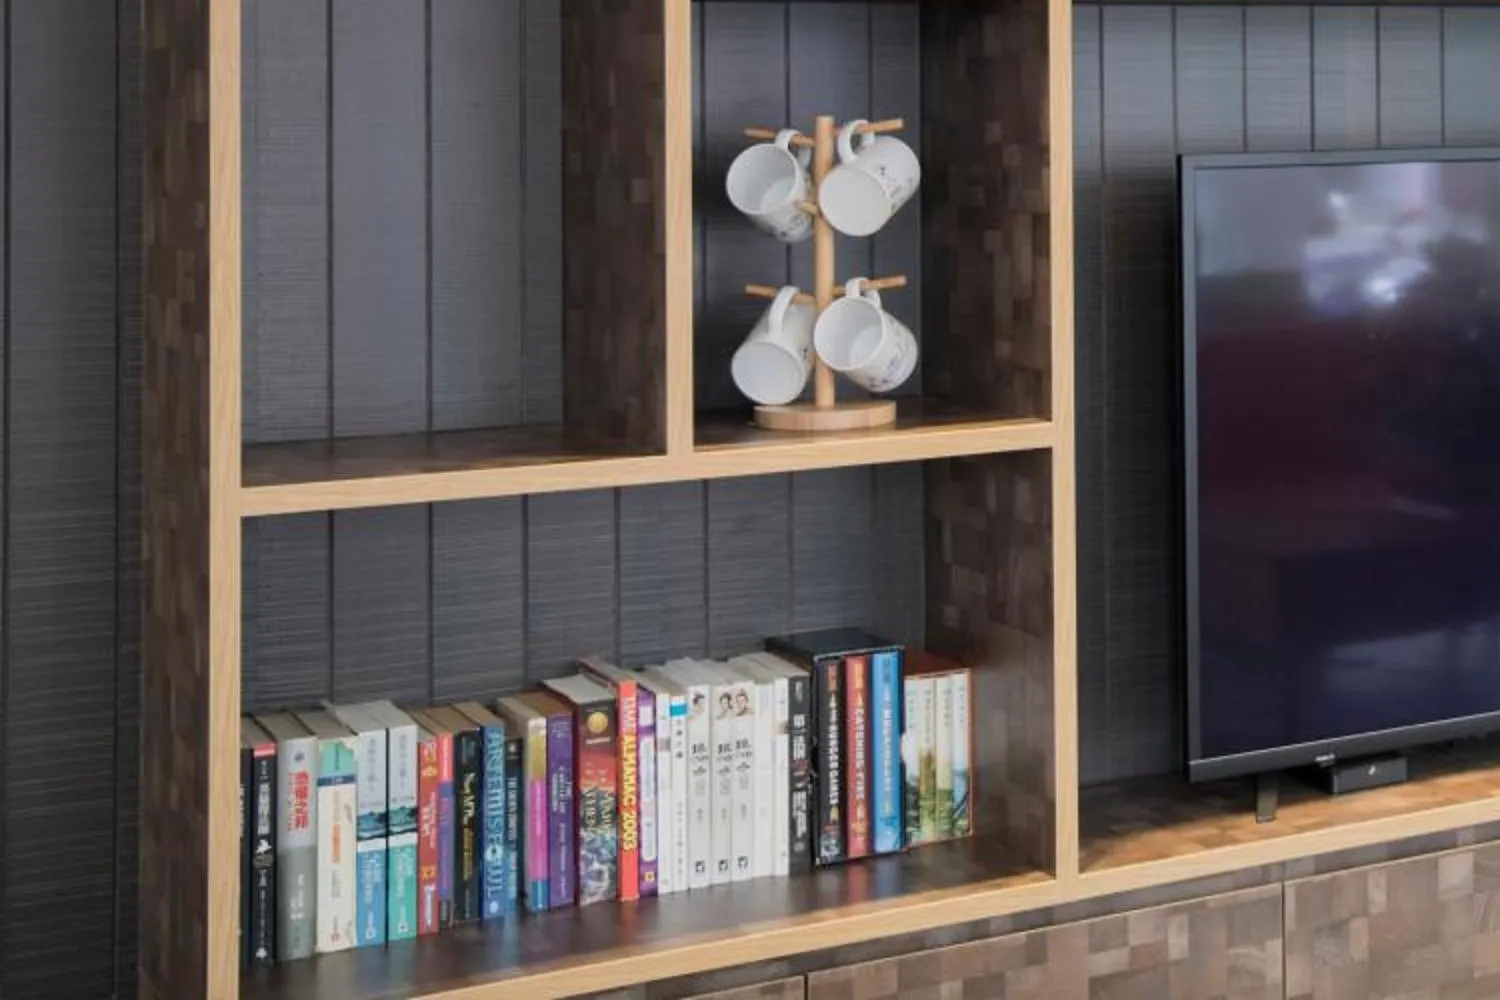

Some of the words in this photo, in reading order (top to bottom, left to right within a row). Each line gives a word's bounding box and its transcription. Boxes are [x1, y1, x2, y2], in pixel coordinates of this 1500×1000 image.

[622, 696, 637, 733] TIME
[486, 731, 505, 833] ARTEMIS
[622, 734, 637, 807] ALMANAC
[622, 810, 637, 851] 2003
